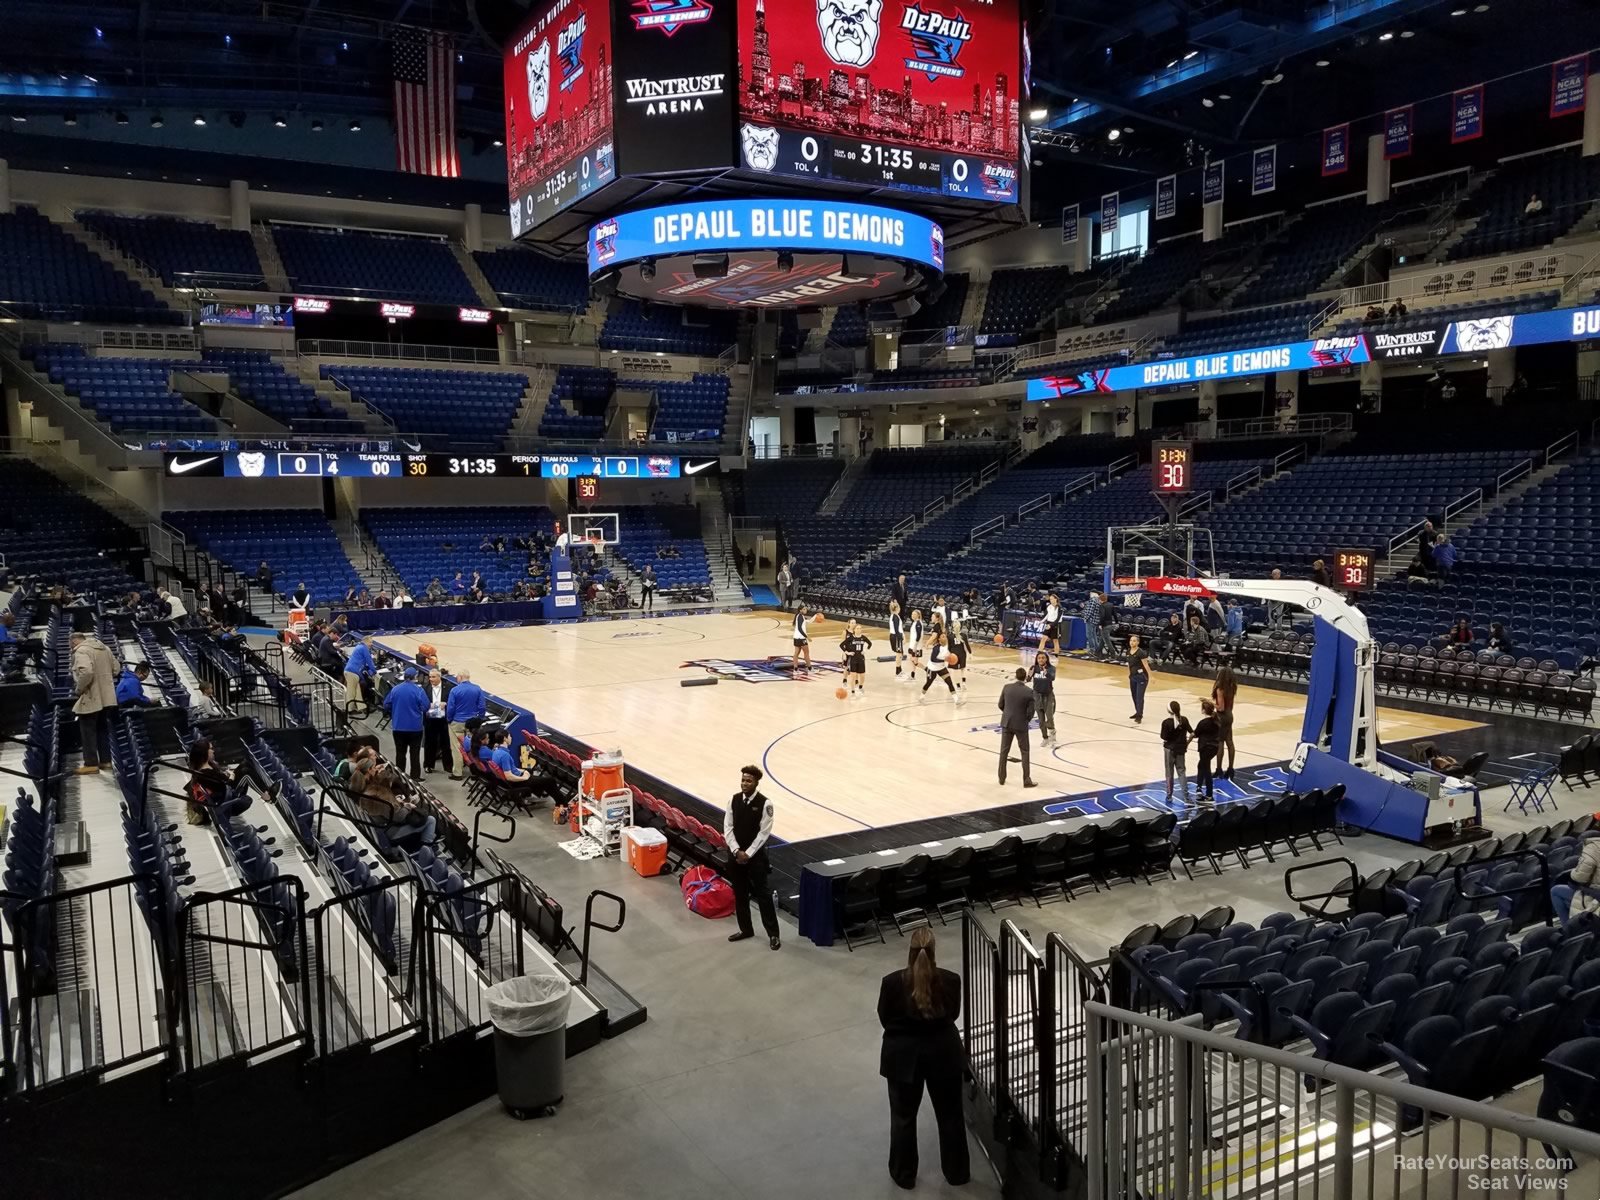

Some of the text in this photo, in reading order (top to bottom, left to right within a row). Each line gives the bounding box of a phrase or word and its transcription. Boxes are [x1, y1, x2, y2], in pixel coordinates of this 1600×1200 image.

[909, 60, 963, 77] BLUE DEMONS
[626, 74, 725, 98] WINTRUST
[1558, 77, 1580, 89] NCAA
[646, 98, 704, 116] ARENA
[1458, 106, 1477, 117] NCAA
[1389, 125, 1407, 136] NCAA
[801, 137, 818, 161] 0
[847, 151, 856, 160] 00
[860, 144, 913, 169] 31:35
[1325, 154, 1345, 167] 1945
[582, 156, 590, 179] 0
[794, 162, 819, 174] TOL 4
[919, 162, 927, 170] 00
[952, 159, 968, 181] 0
[882, 170, 894, 180] 1st
[546, 170, 566, 198] 31:35
[949, 184, 963, 192] TOL
[527, 194, 534, 215] 0
[654, 209, 741, 244] DEPAUL
[751, 209, 813, 237] BLUE
[823, 212, 904, 246] DEMONS
[1375, 331, 1436, 346] WINTRUST
[1386, 346, 1423, 357] ARENA
[1144, 348, 1290, 384] DEPAUL BLUE DEMONS
[512, 455, 540, 463] PERIOD
[1160, 449, 1186, 462] 31:34
[295, 457, 307, 474] 0
[327, 462, 339, 474] 4
[371, 462, 390, 475] 00
[410, 462, 427, 475] 30
[449, 458, 496, 474] 31:35
[523, 464, 529, 475] 1
[552, 464, 569, 476] 00
[592, 464, 602, 476] 4
[618, 461, 627, 474] 0
[1163, 464, 1183, 488] 30
[582, 485, 595, 497] 30
[1340, 555, 1368, 566] 31:34
[1346, 567, 1362, 583] 30
